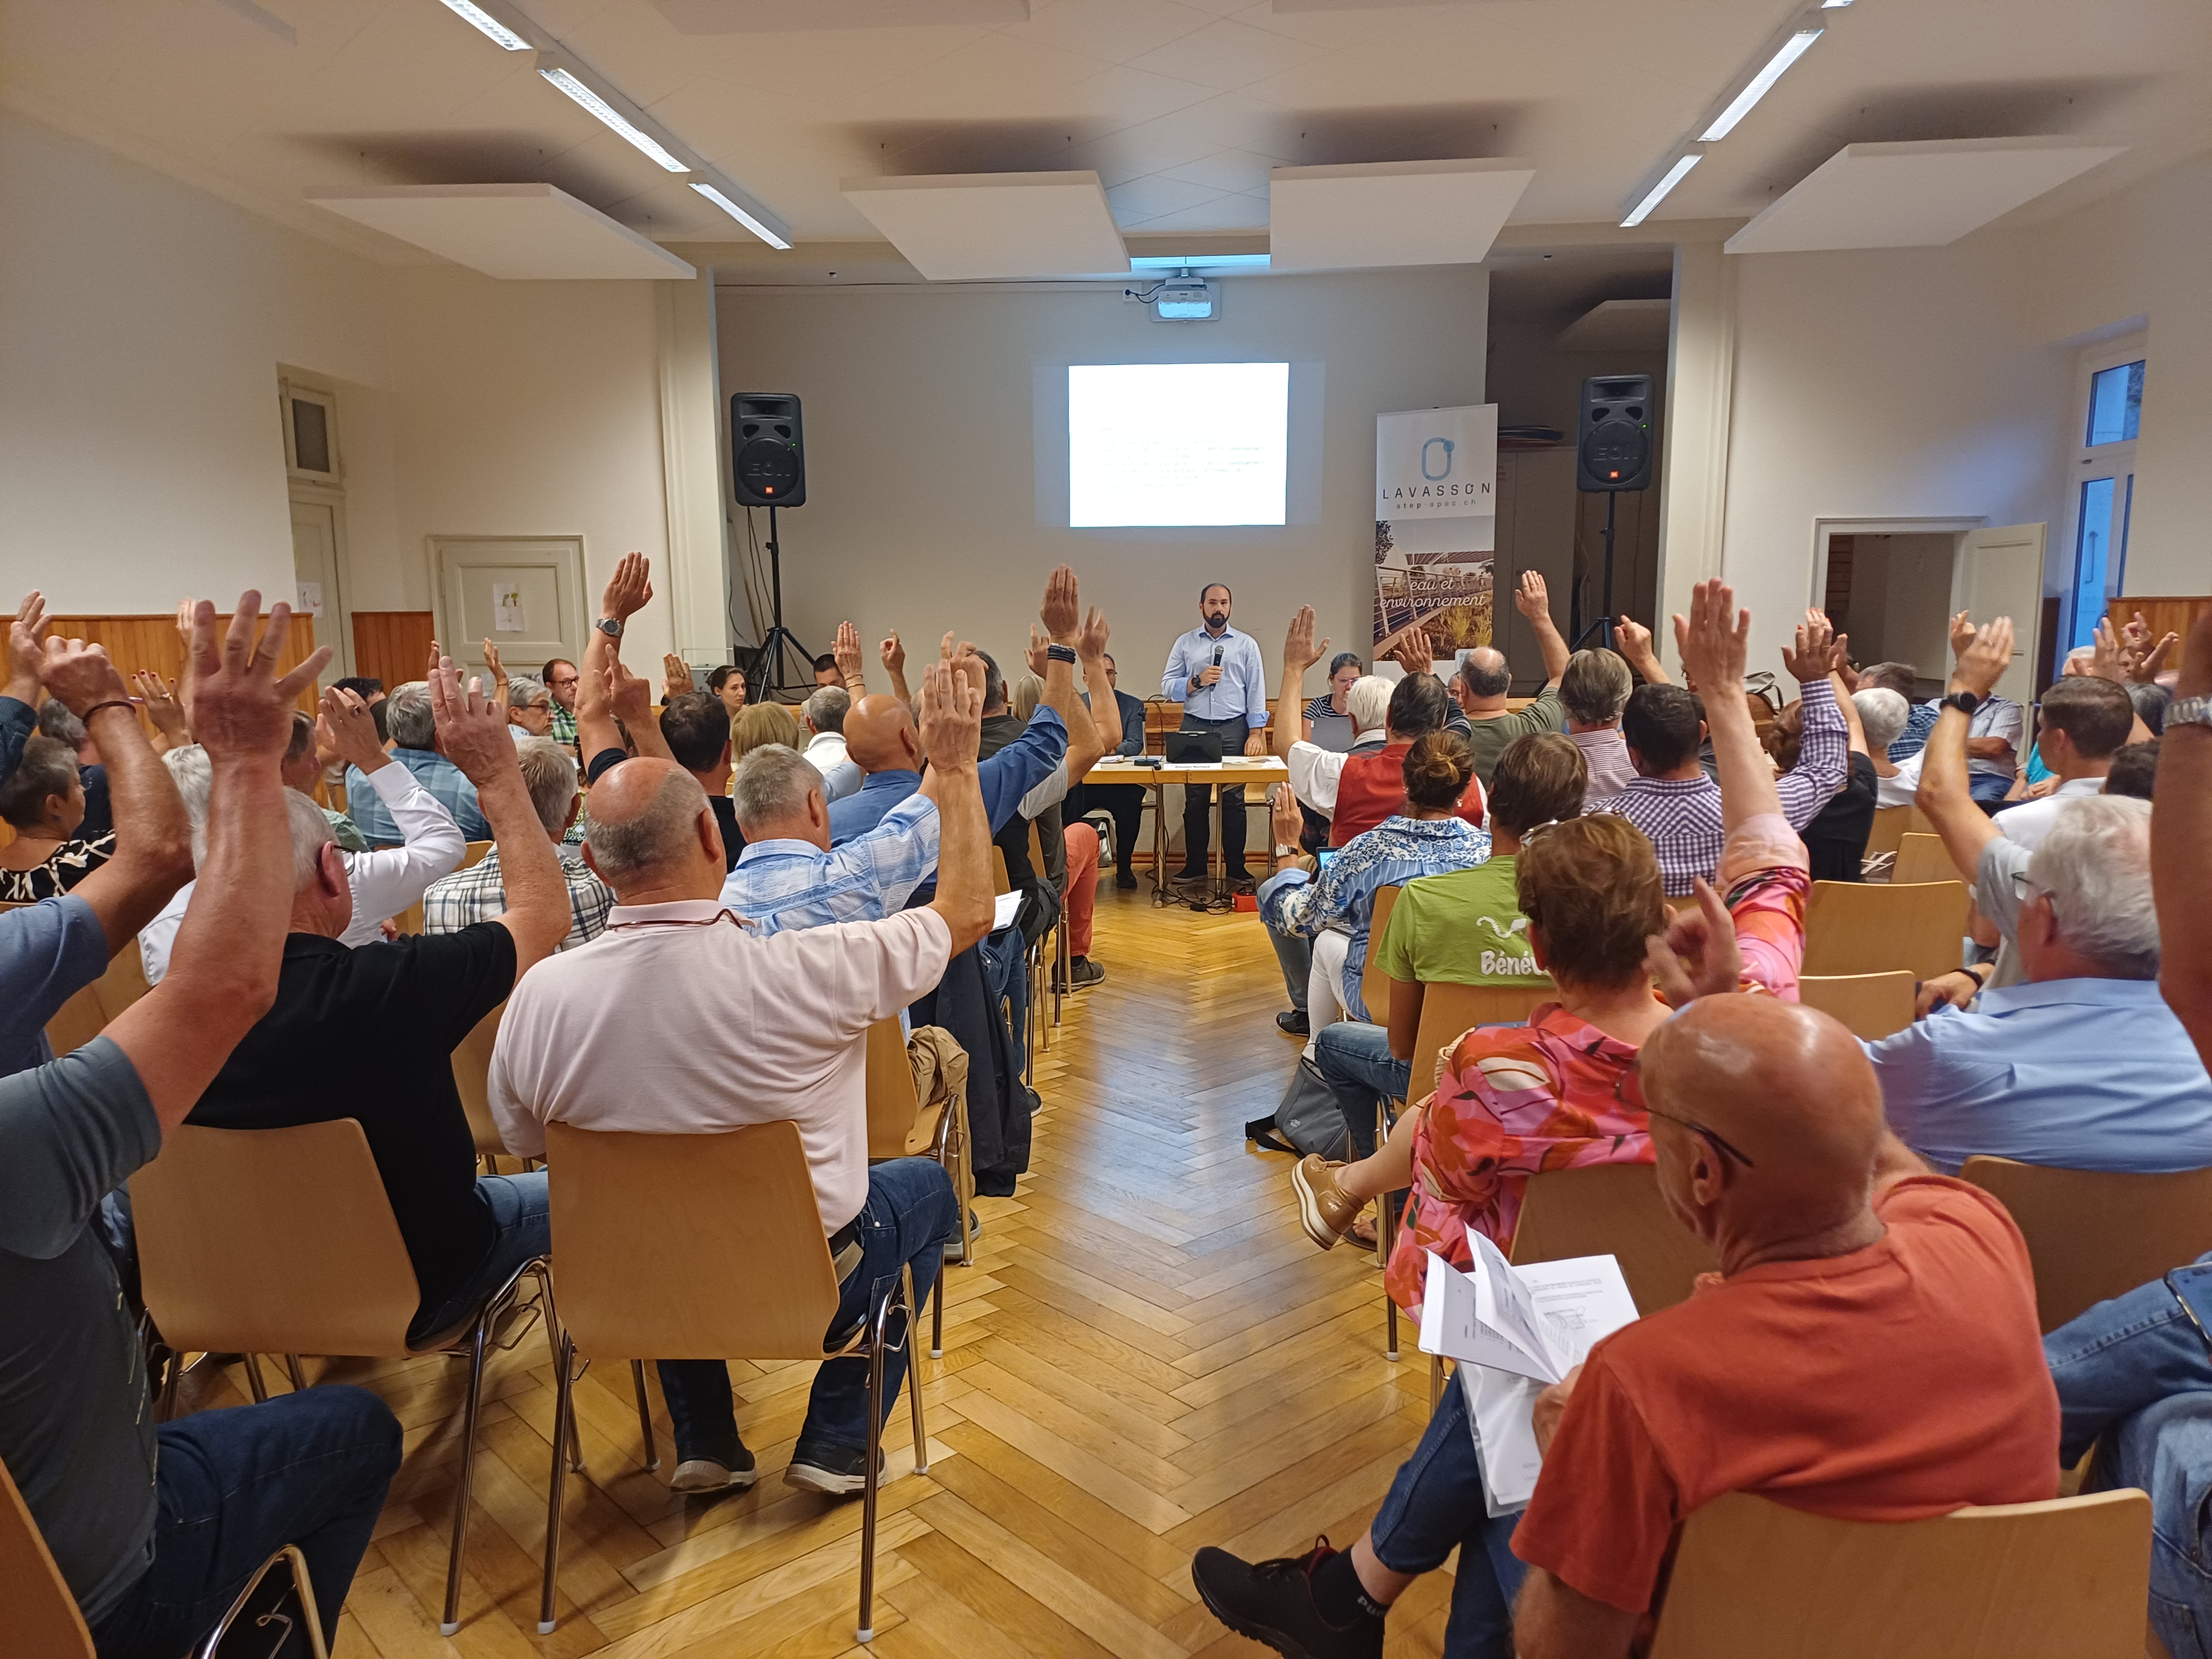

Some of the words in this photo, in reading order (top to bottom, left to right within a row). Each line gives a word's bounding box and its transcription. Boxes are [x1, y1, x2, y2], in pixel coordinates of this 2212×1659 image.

[1383, 483, 1490, 499] LAVASSON
[1410, 581, 1437, 591] eau
[1441, 577, 1455, 589] et
[1380, 594, 1486, 608] environnement
